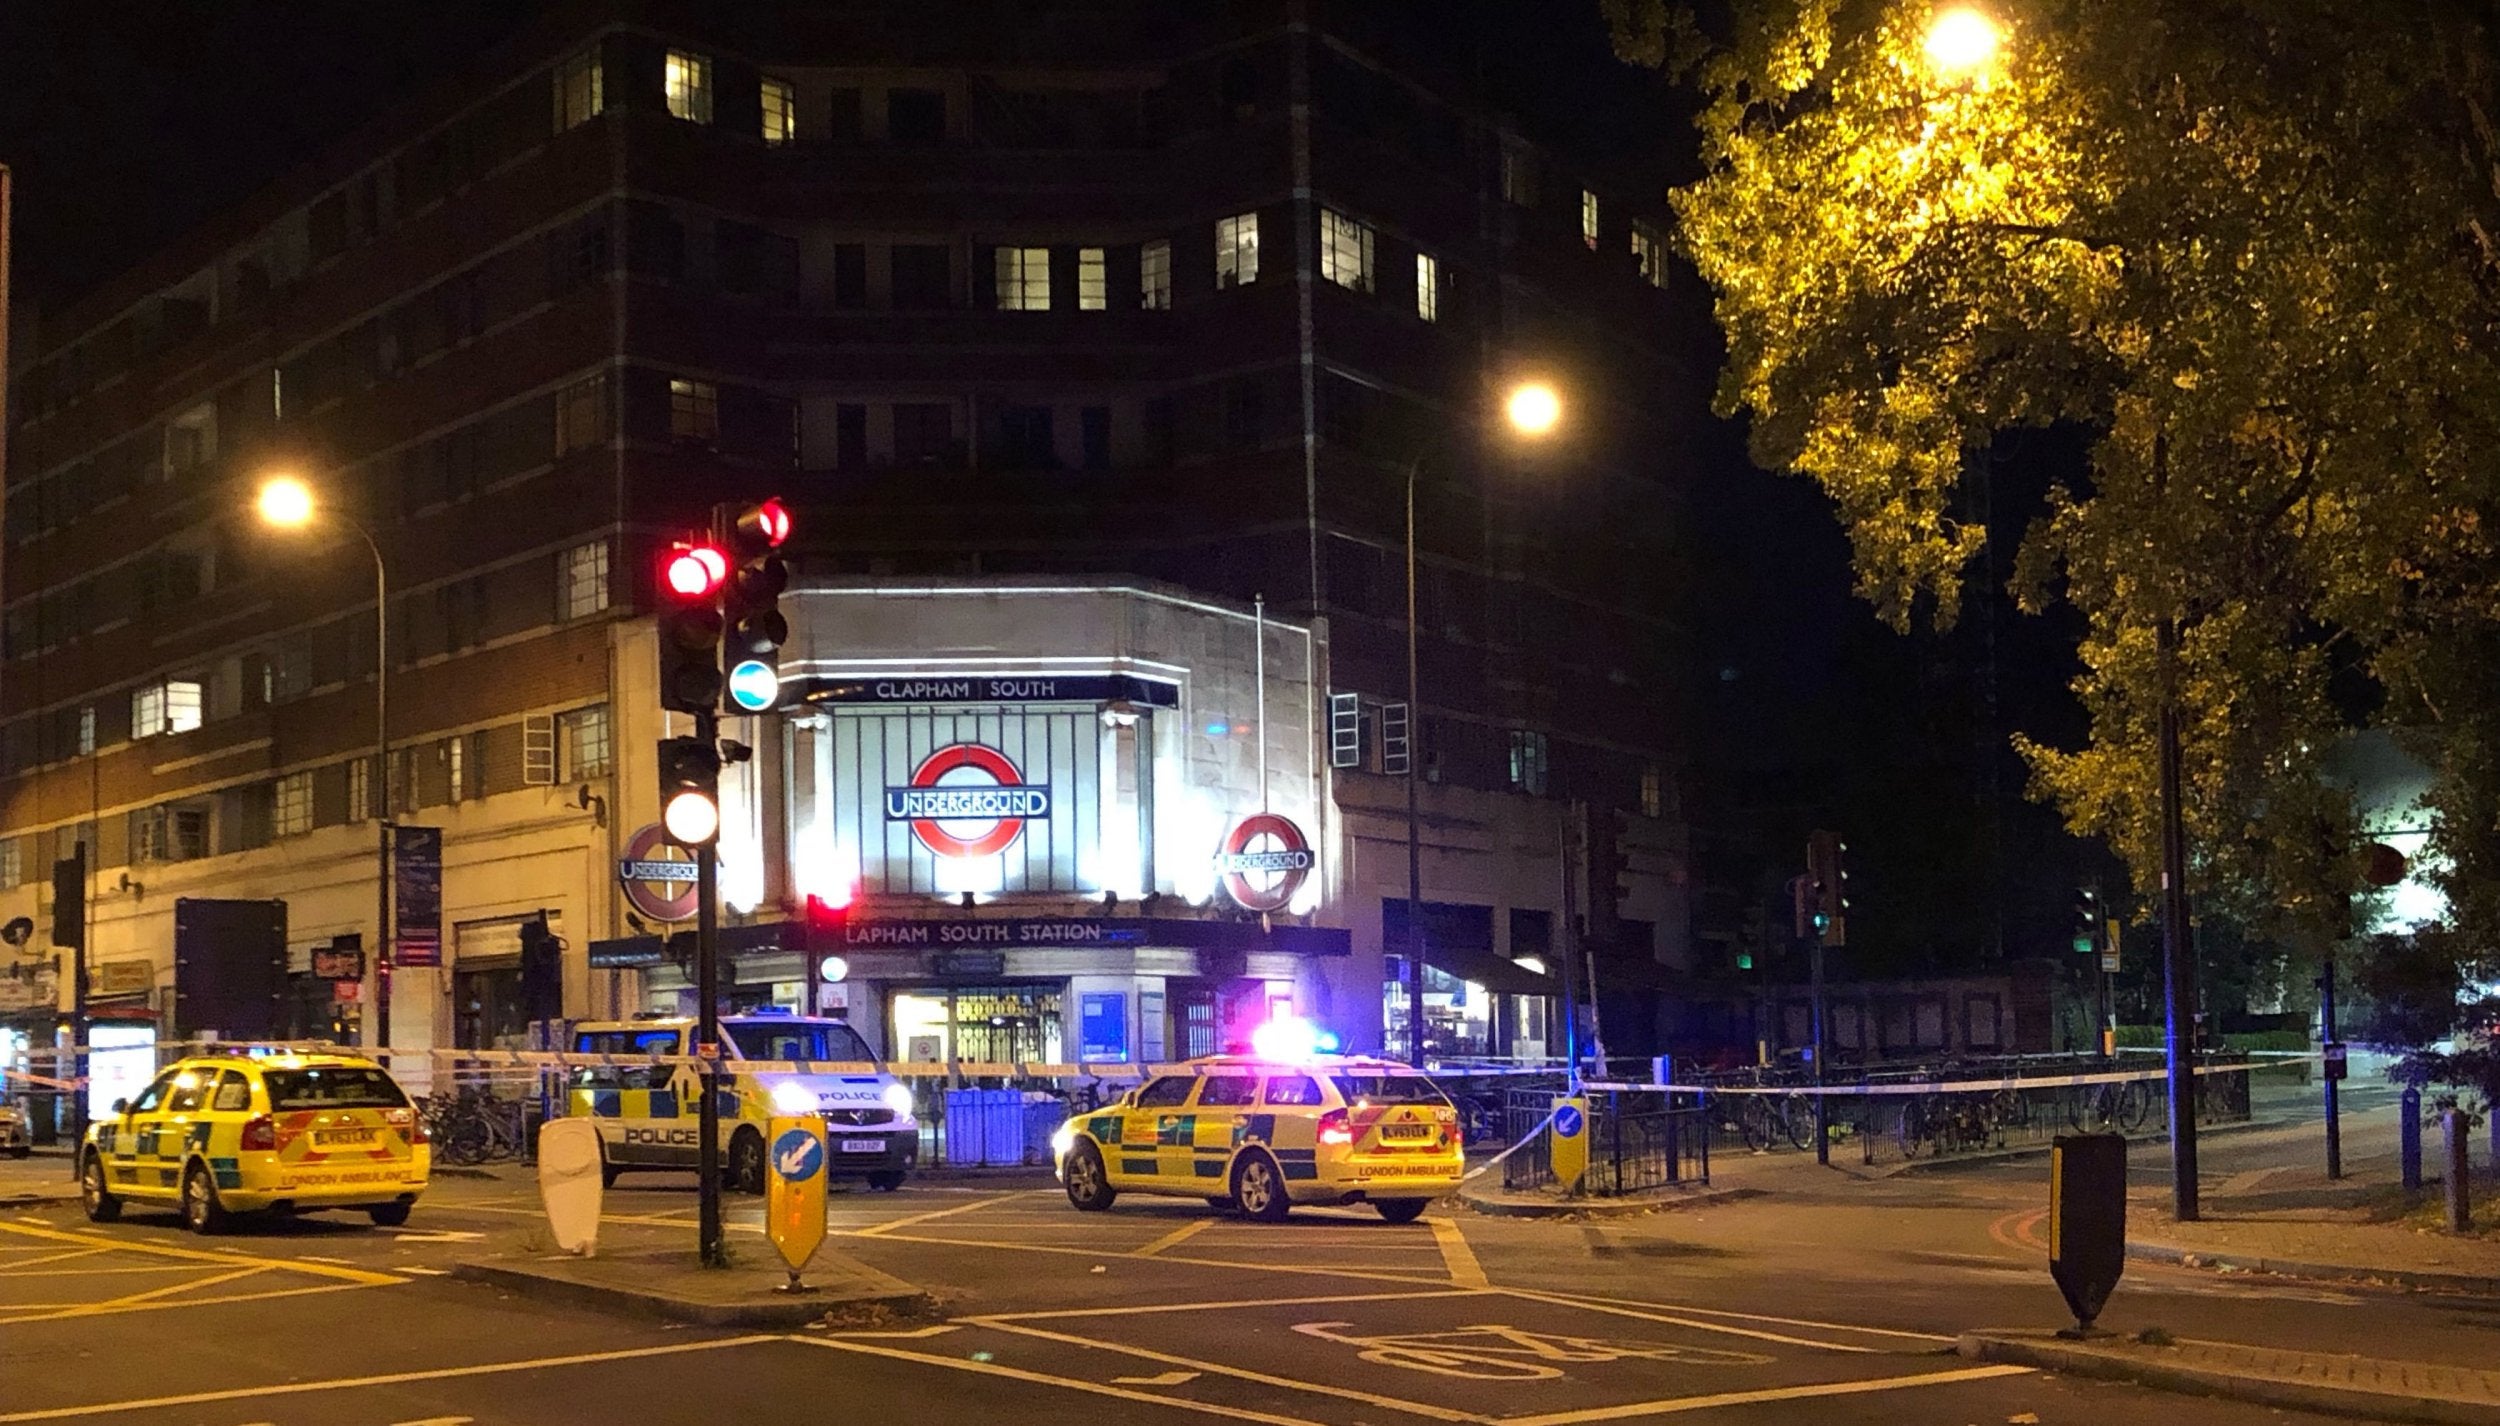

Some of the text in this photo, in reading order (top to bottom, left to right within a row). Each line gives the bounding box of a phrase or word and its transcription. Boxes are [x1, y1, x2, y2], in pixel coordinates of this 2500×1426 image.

[876, 680, 1055, 698] CLAPHAM SOUTH
[887, 790, 1048, 818] UNDERGROUND
[846, 923, 1101, 943] LAPHAM SOUTH STATION
[818, 1091, 882, 1102] POLICE
[625, 1128, 698, 1146] POLICE
[281, 1170, 414, 1185] LONDON AMBULANCE
[1359, 1165, 1459, 1177] LONDON AMBULANCE
